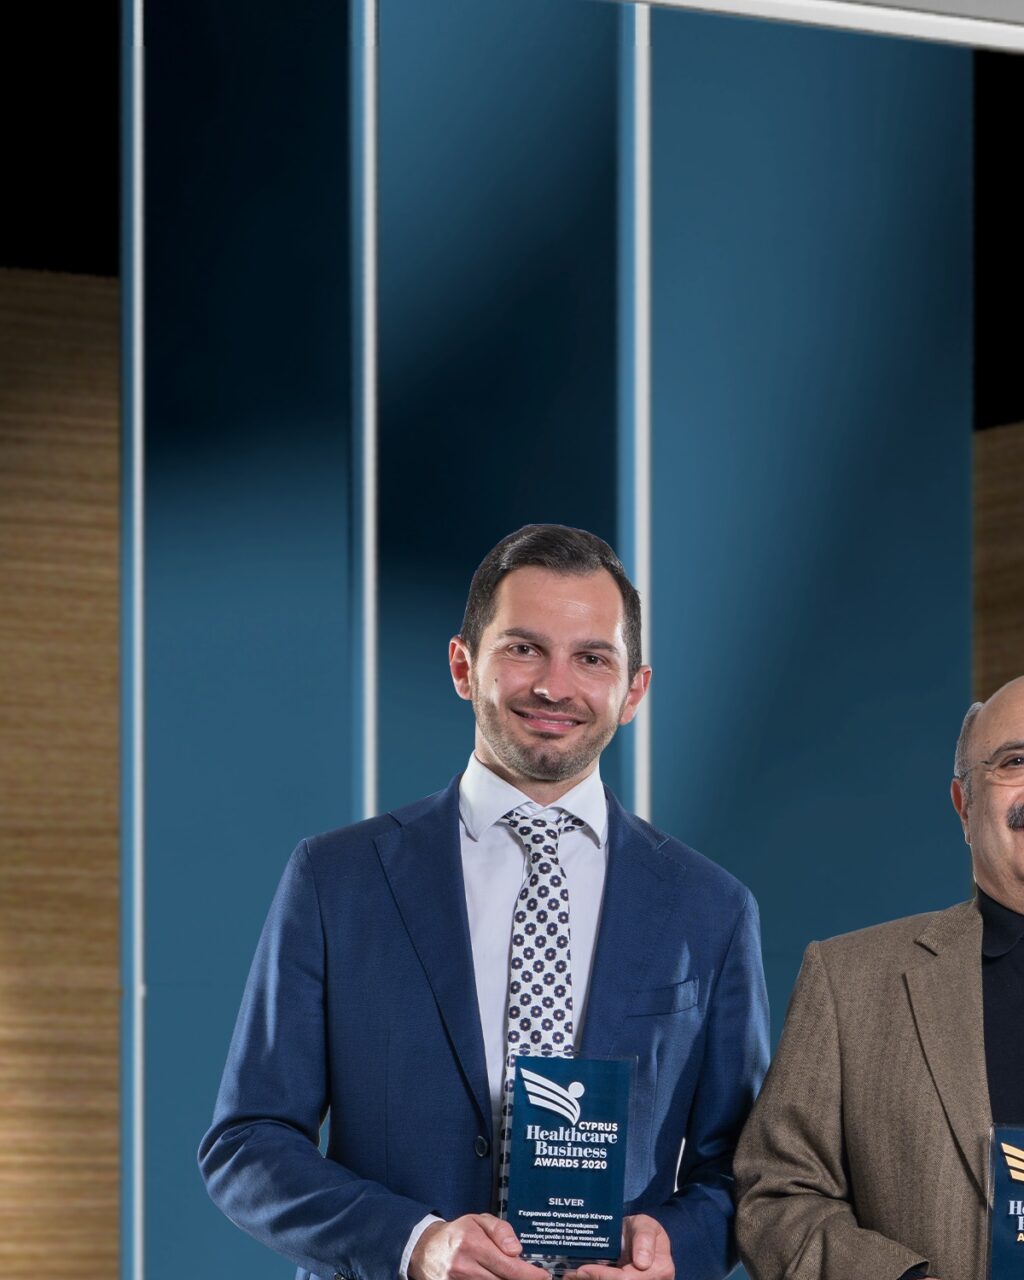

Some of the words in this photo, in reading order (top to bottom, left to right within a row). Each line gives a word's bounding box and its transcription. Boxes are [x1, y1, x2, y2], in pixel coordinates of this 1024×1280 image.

[578, 1122, 618, 1132] CYPRUS
[526, 1125, 618, 1144] Healthcare
[534, 1140, 608, 1158] Business
[534, 1158, 579, 1168] AWARDS
[582, 1159, 608, 1170] 2020
[548, 1198, 584, 1206] SILVER
[518, 1210, 551, 1218] Γερμανικό
